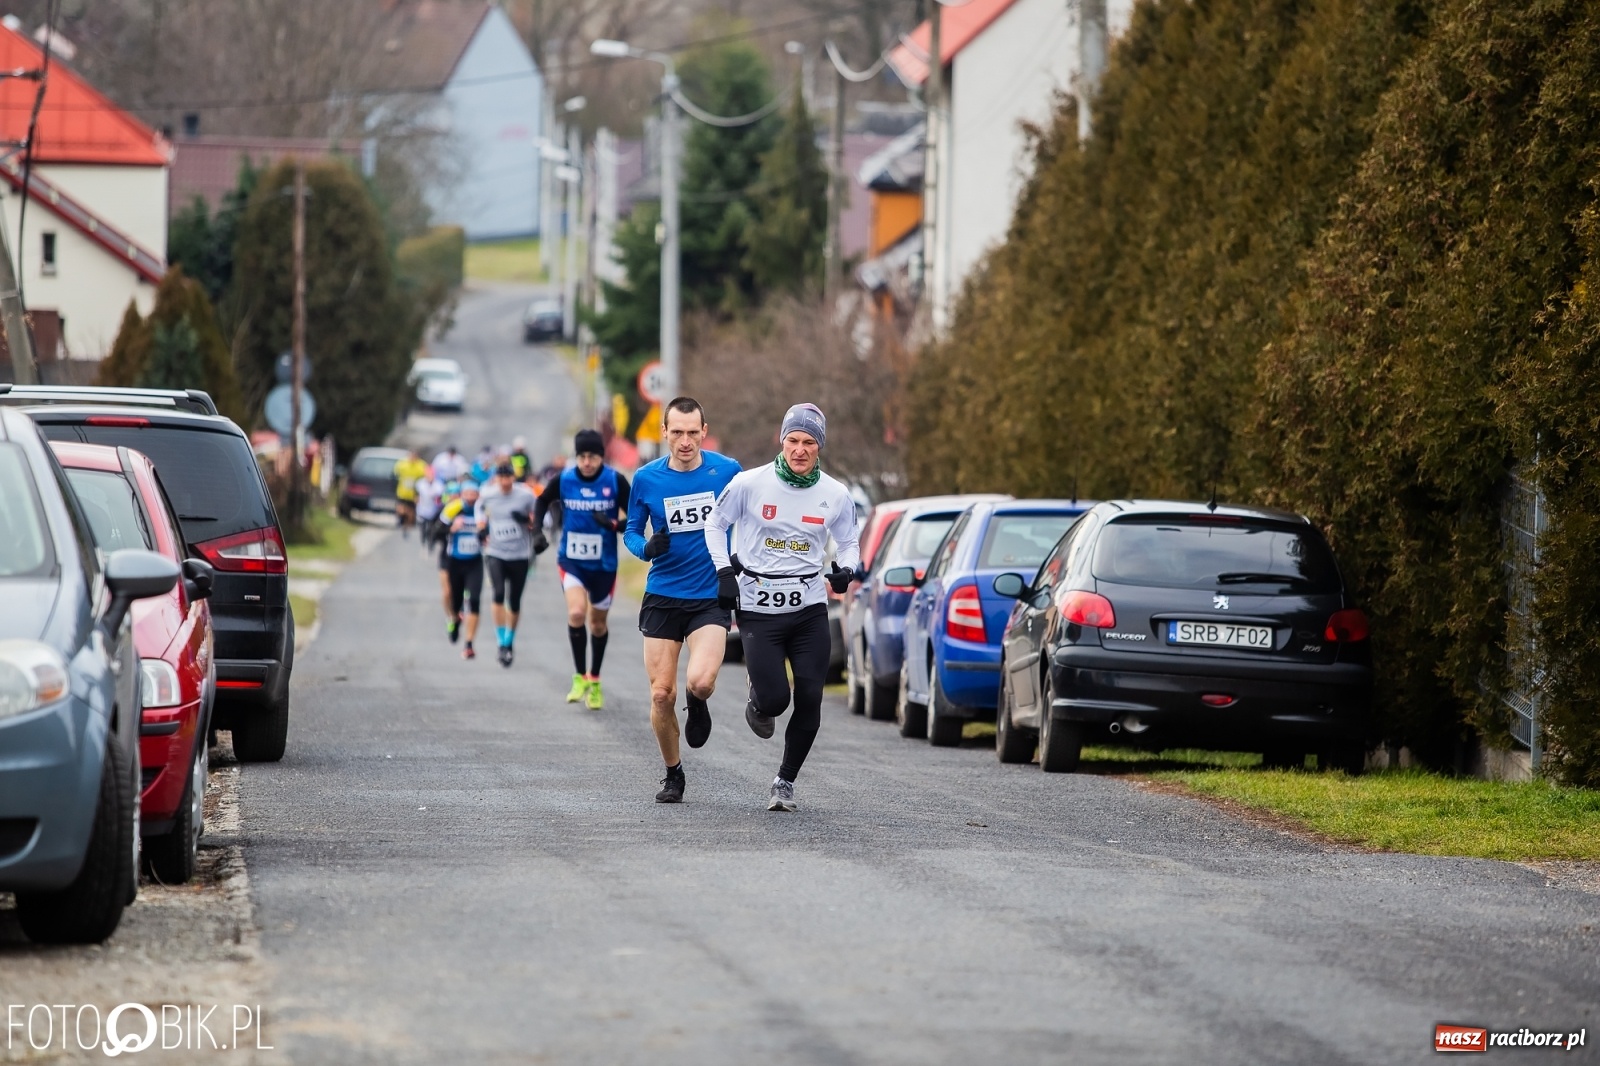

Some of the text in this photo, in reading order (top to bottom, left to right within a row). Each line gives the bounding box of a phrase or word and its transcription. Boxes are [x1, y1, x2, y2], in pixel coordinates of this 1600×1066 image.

[669, 505, 713, 526] 458
[571, 543, 598, 555] 131
[756, 591, 802, 608] 298
[1105, 632, 1147, 641] PEUGEOT
[1180, 624, 1269, 647] SRB 7F02
